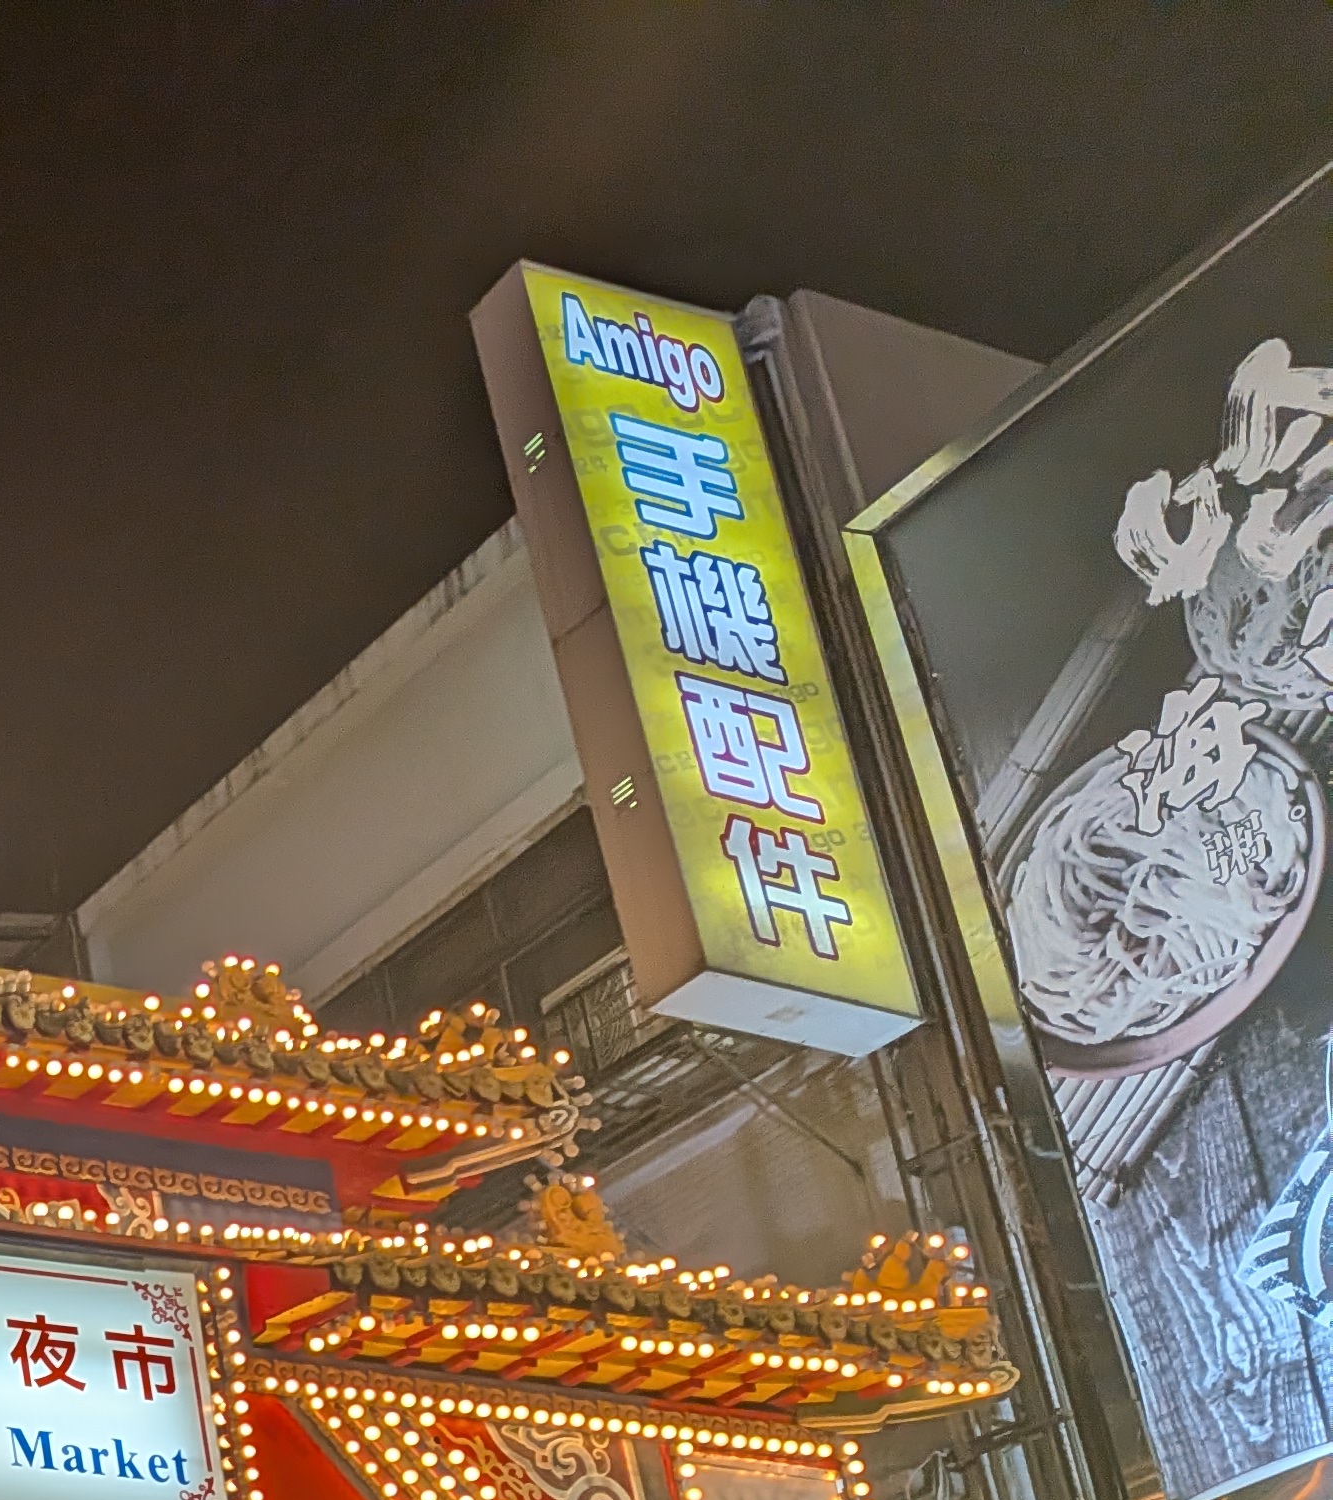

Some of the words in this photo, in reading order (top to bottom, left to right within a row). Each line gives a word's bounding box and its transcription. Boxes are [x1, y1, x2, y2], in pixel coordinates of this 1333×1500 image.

[562, 292, 724, 412] Amigo
[610, 411, 853, 961] 手機配件
[9, 1426, 191, 1487] Market
